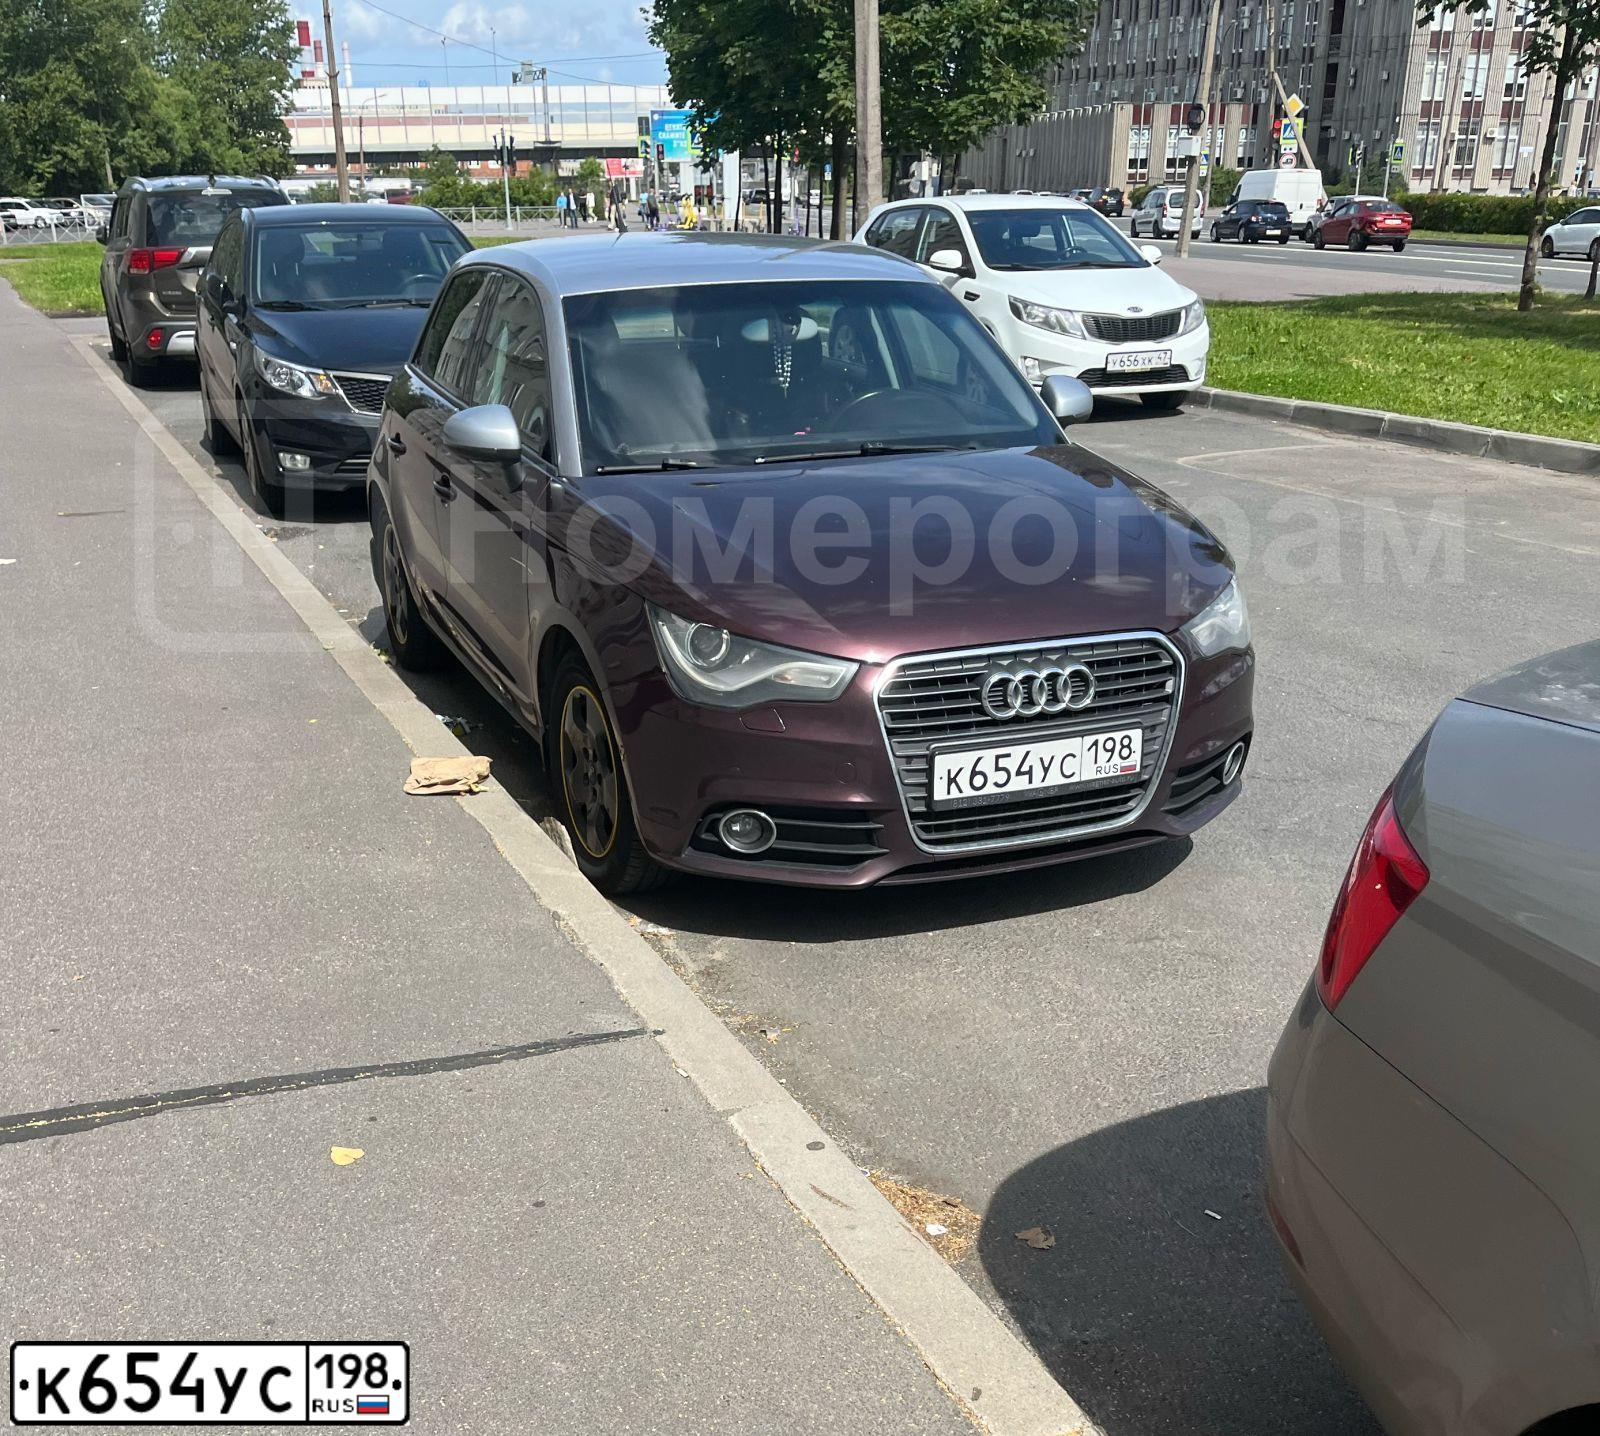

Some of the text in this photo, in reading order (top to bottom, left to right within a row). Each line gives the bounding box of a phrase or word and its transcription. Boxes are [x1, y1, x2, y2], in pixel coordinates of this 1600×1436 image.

[946, 734, 1133, 795] К654УС 198
[1095, 763, 1119, 776] RUS
